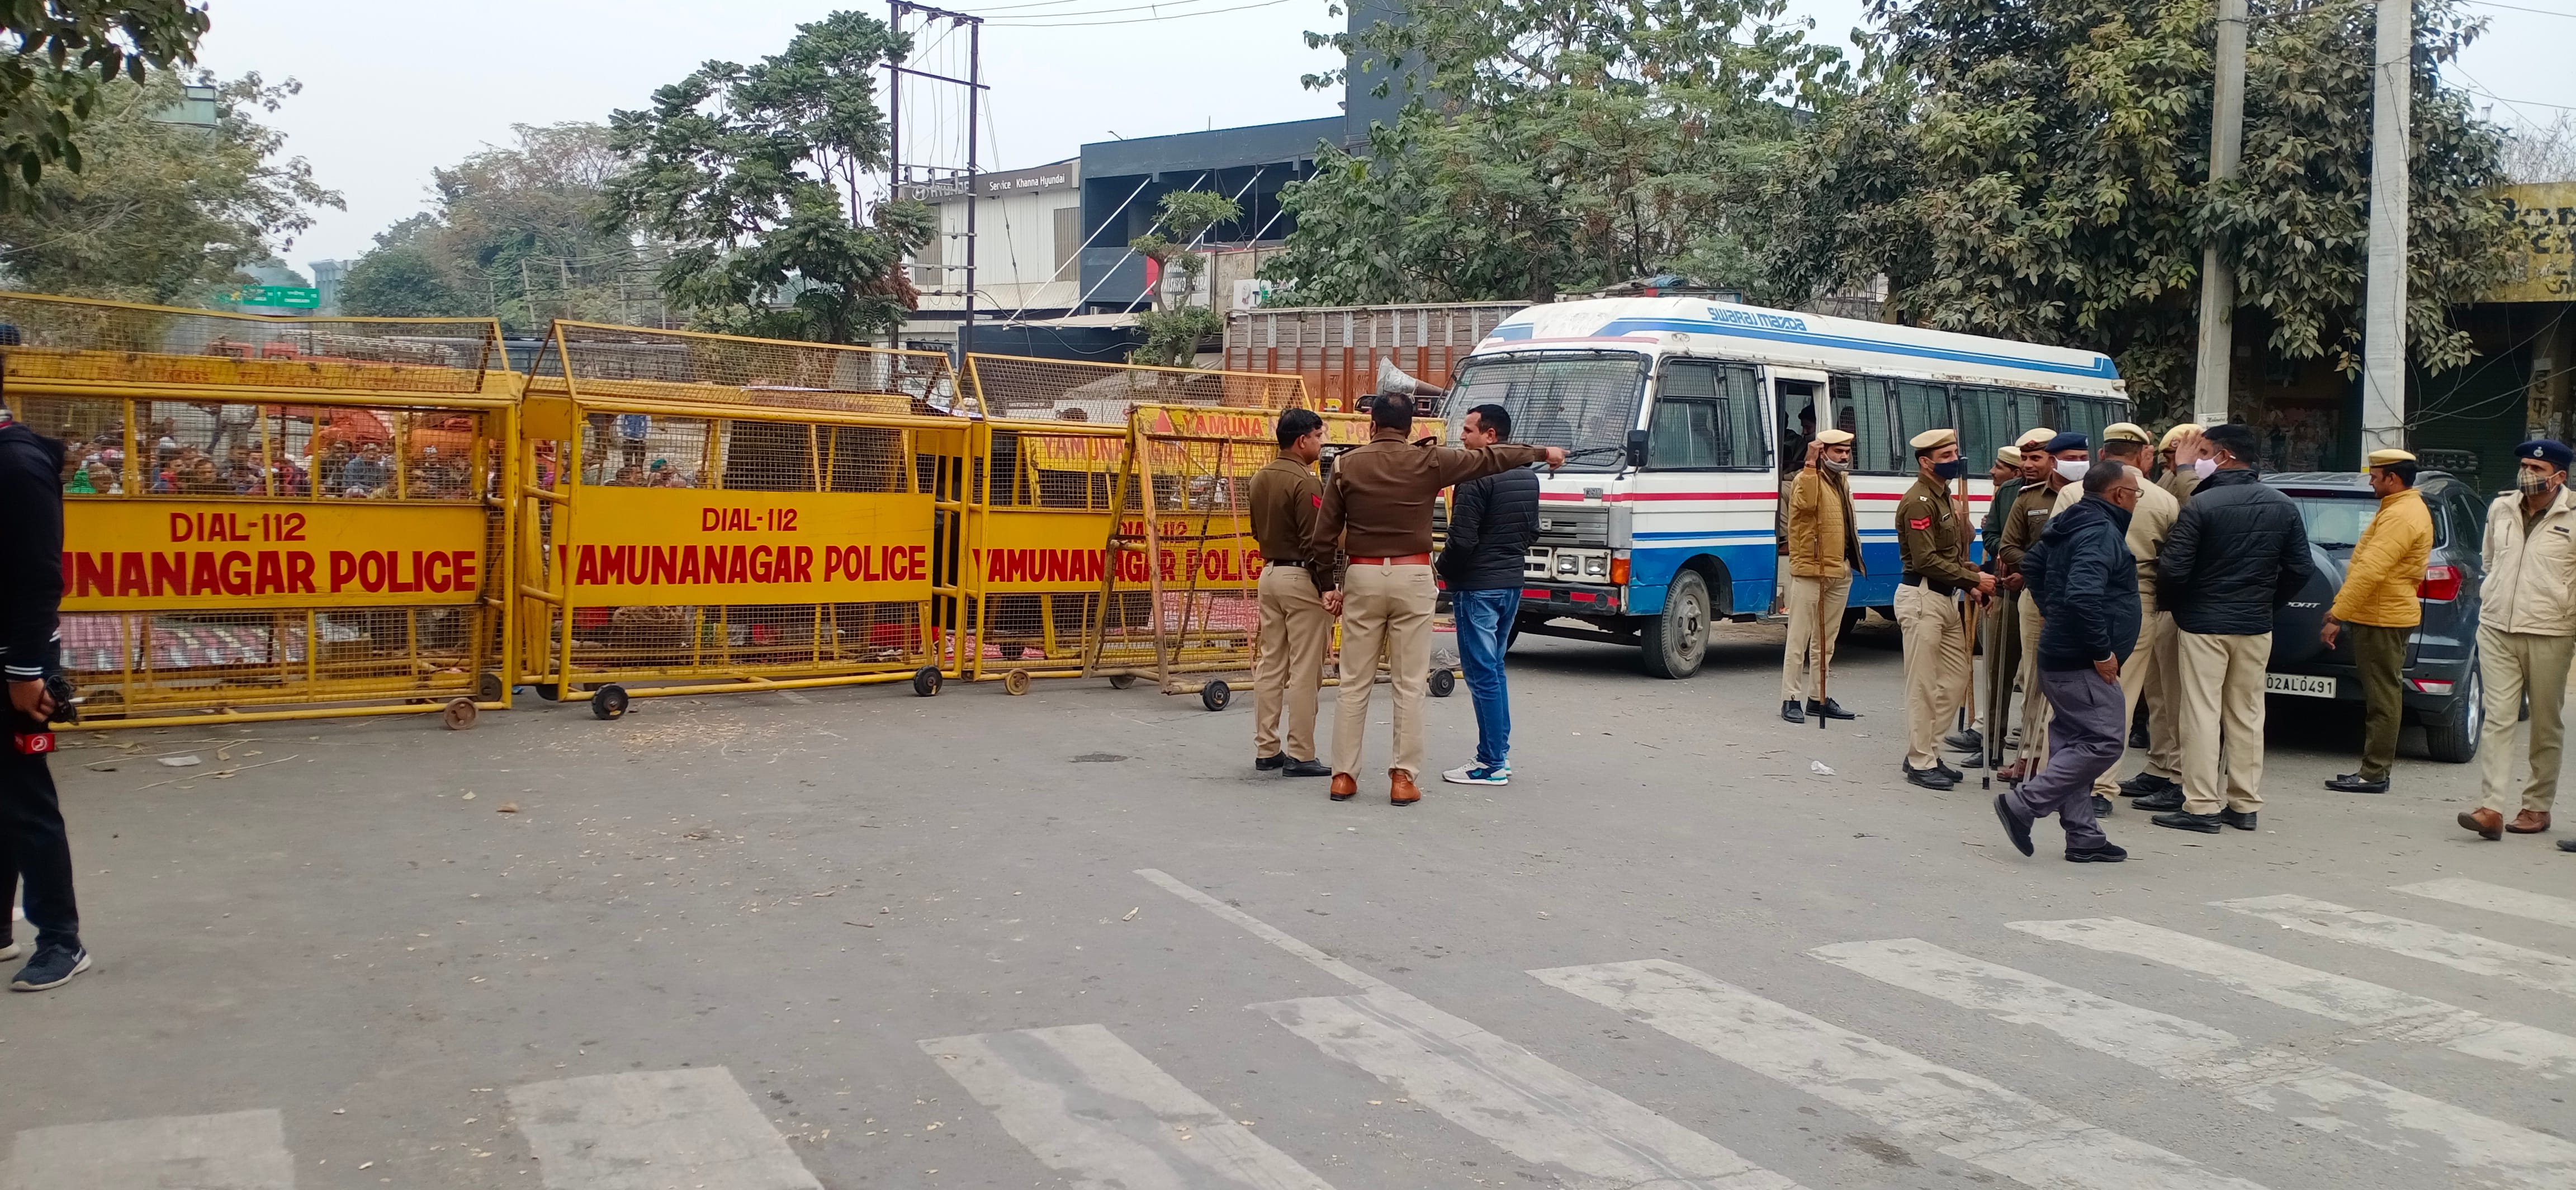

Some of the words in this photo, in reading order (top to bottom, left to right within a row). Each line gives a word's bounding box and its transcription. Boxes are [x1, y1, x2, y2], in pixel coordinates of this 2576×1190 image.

[989, 181, 1011, 191] Service
[1016, 178, 1039, 188] Khanna
[1040, 173, 1065, 187] Hyundai
[170, 512, 306, 542] DIAL-112
[702, 508, 798, 532] DIAL-112
[330, 550, 476, 593] POLICE
[823, 545, 927, 582] POLICE
[1186, 549, 1265, 580] POLIC
